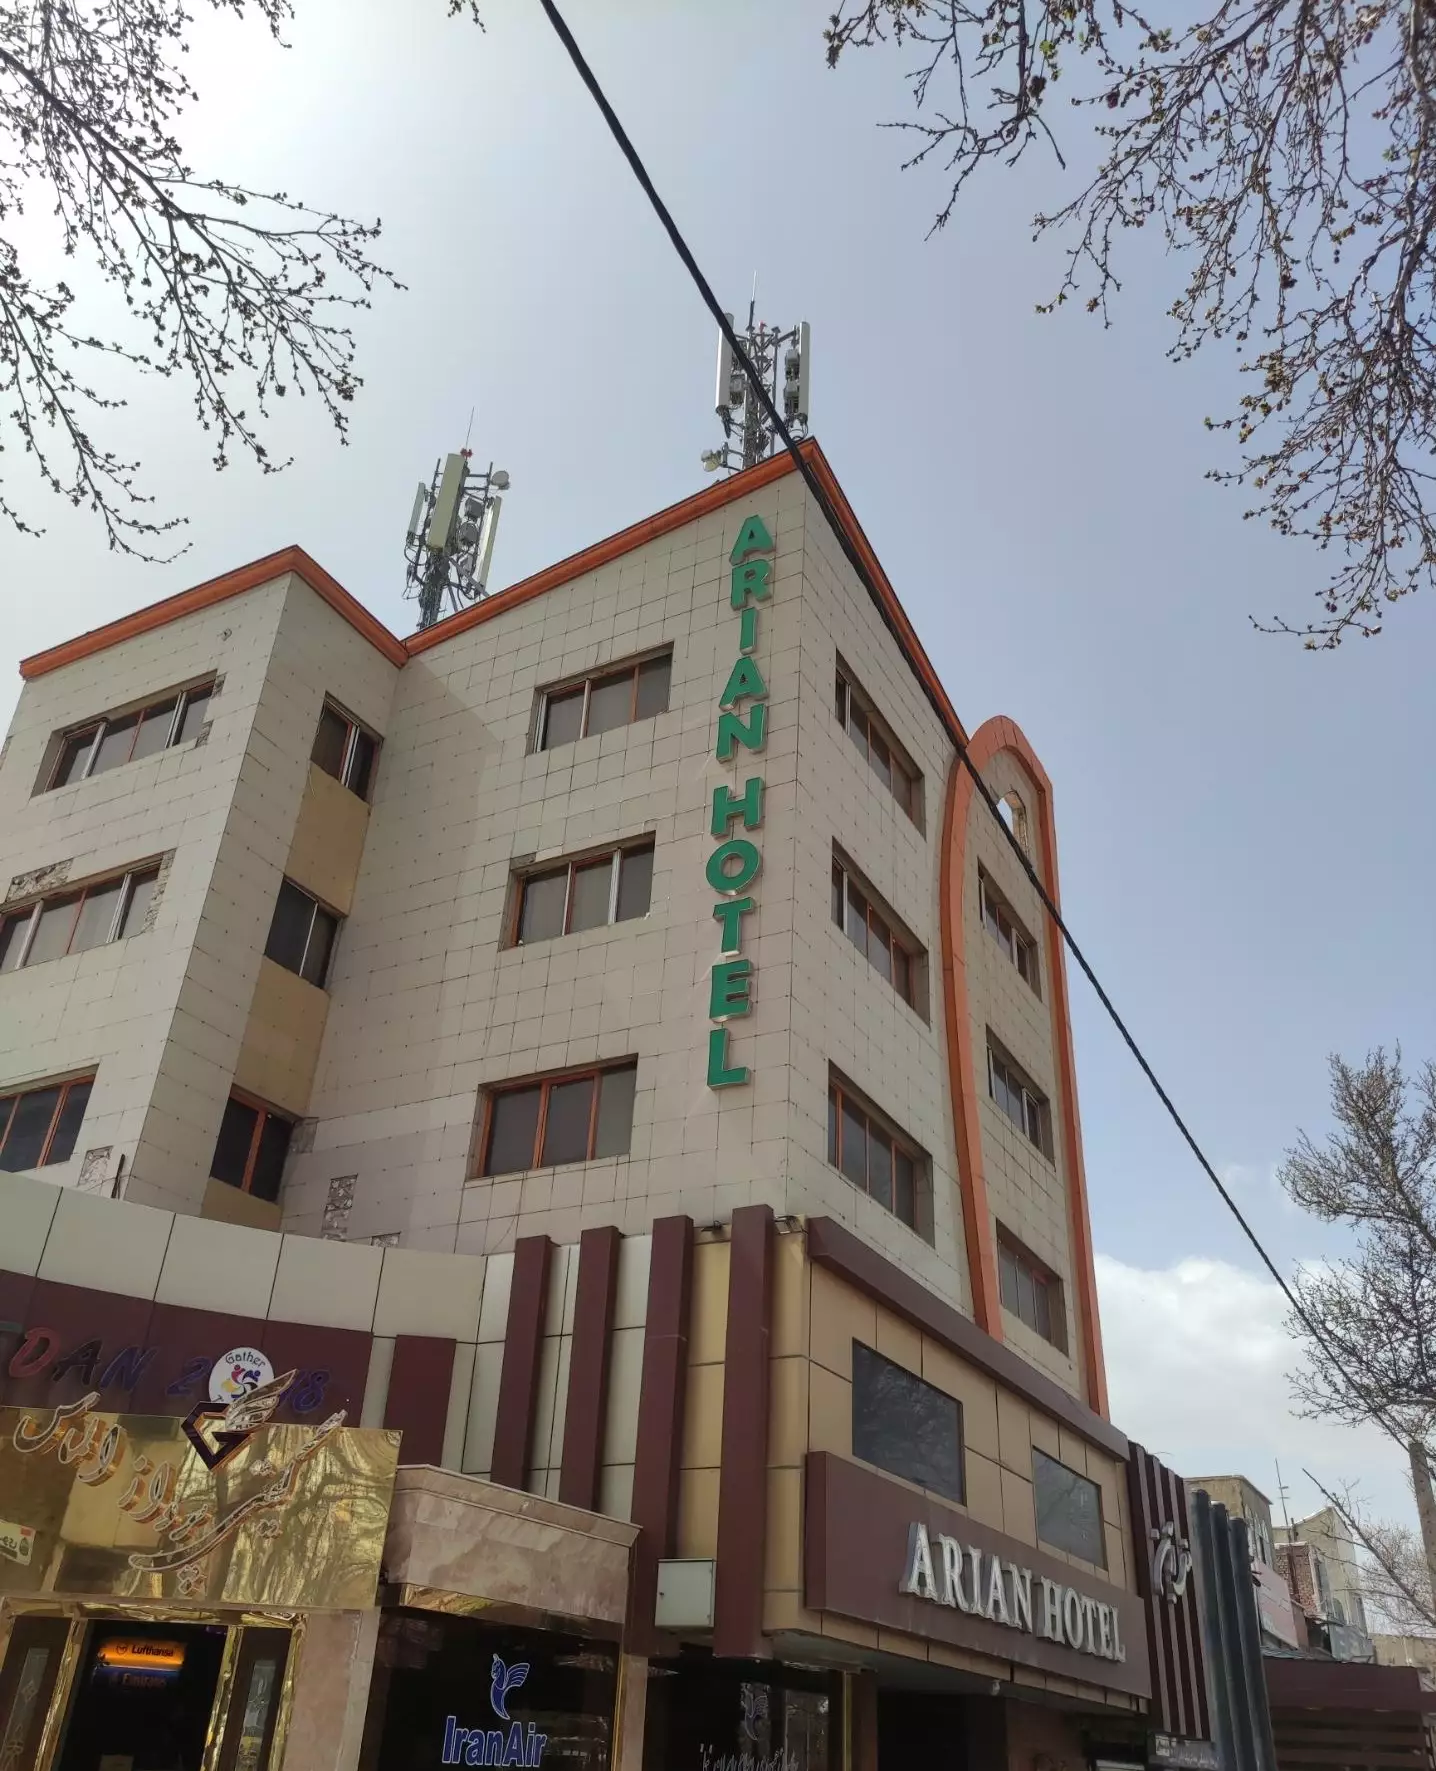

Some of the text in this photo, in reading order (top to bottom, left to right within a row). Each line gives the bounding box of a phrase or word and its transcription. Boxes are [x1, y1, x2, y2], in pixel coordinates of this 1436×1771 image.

[706, 514, 774, 1090] ARIAN HOTEL
[0, 1321, 157, 1392] DAN
[226, 1351, 266, 1367] Gather
[900, 1521, 1034, 1634] ARIAN
[1037, 1582, 1127, 1663] HOTEL
[131, 1643, 174, 1657] Lufthansa
[441, 1714, 547, 1769] IranAir
